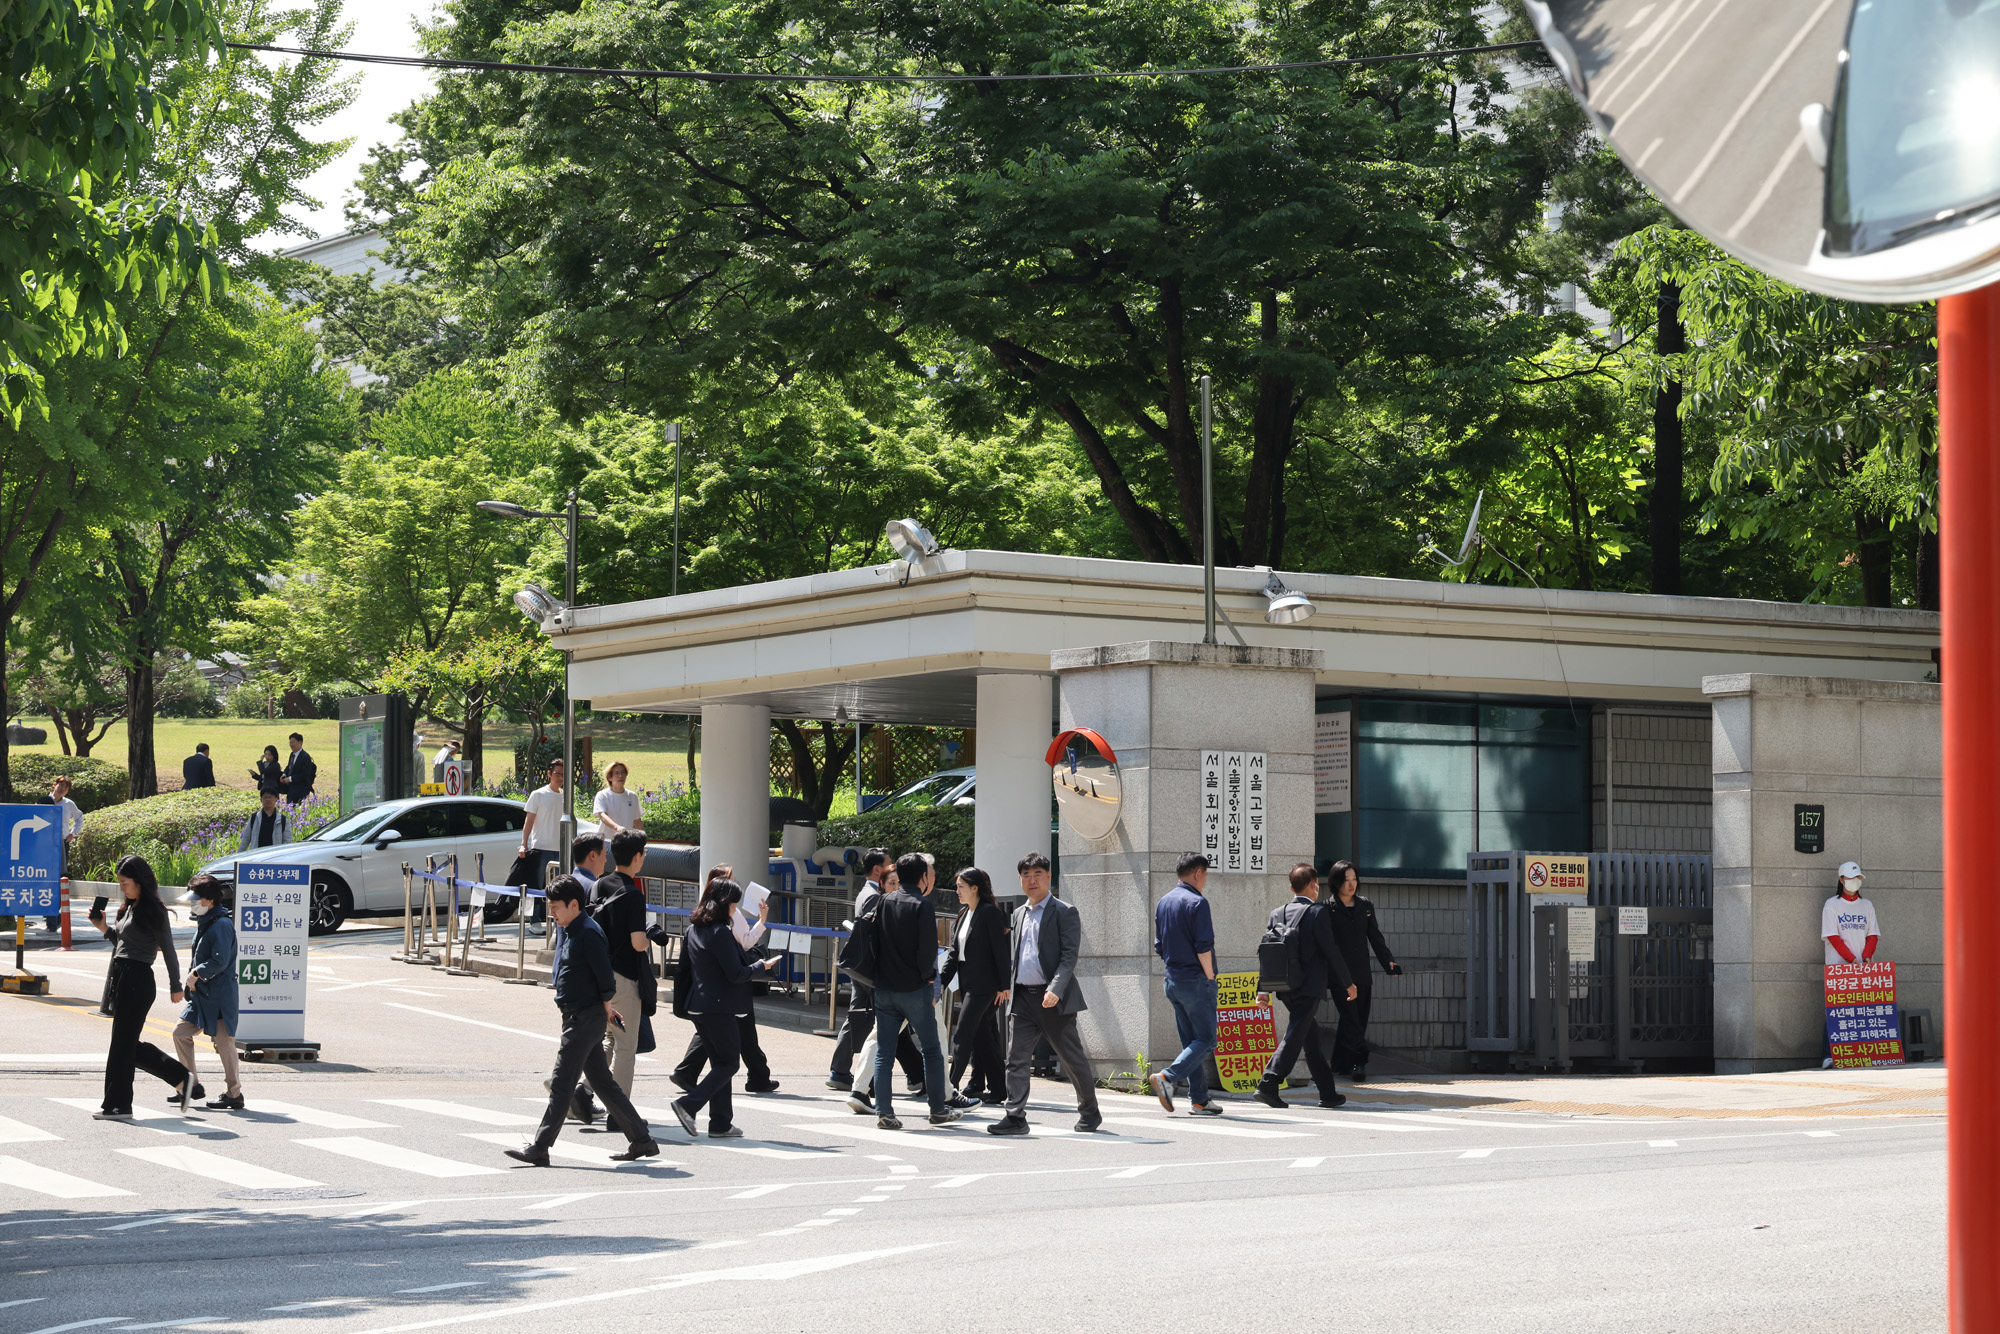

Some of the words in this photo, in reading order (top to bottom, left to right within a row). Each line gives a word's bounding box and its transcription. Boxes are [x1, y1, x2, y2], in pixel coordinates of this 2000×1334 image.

[1206, 754, 1219, 869] 서울회생법원
[1228, 755, 1241, 870] 서울중앙지방법원
[1250, 755, 1263, 871] 서울고등법원
[1798, 811, 1821, 827] 157
[9, 865, 48, 878] 150m
[248, 868, 274, 880] 승용차
[277, 869, 300, 881] 5부제
[1550, 863, 1585, 874] 오토바이
[1550, 876, 1585, 888] 진입금지
[0, 888, 54, 907] 주차장
[242, 893, 268, 903] 오늘은
[274, 893, 302, 905] 수요일
[244, 910, 270, 930] 3,8
[274, 918, 291, 928] 쉬는
[294, 918, 303, 928] 날
[239, 944, 266, 955] 내일은
[273, 945, 301, 956] 목요일
[242, 963, 268, 983] 4,9
[272, 969, 289, 980] 쉬는
[292, 969, 301, 980] 날
[1827, 962, 1892, 976] 25고단6414
[1216, 976, 1259, 989] 5고단64
[1826, 977, 1859, 990] 박강균
[1861, 975, 1894, 989] 판사님
[1217, 991, 1238, 1005] 강균
[1827, 990, 1894, 1004] 아도인터네셔널
[1829, 1007, 1855, 1018] 4년째
[1856, 1005, 1894, 1016] 피눈물을
[1838, 1019, 1866, 1030] 흘리고
[1868, 1018, 1887, 1028] 있는
[1830, 1031, 1859, 1041] 수많은
[1860, 1028, 1897, 1039] 피해자들
[1832, 1044, 1855, 1057] 아도
[1857, 1041, 1900, 1056] 사기꾼들
[1834, 1057, 1872, 1069] 강력처벌
